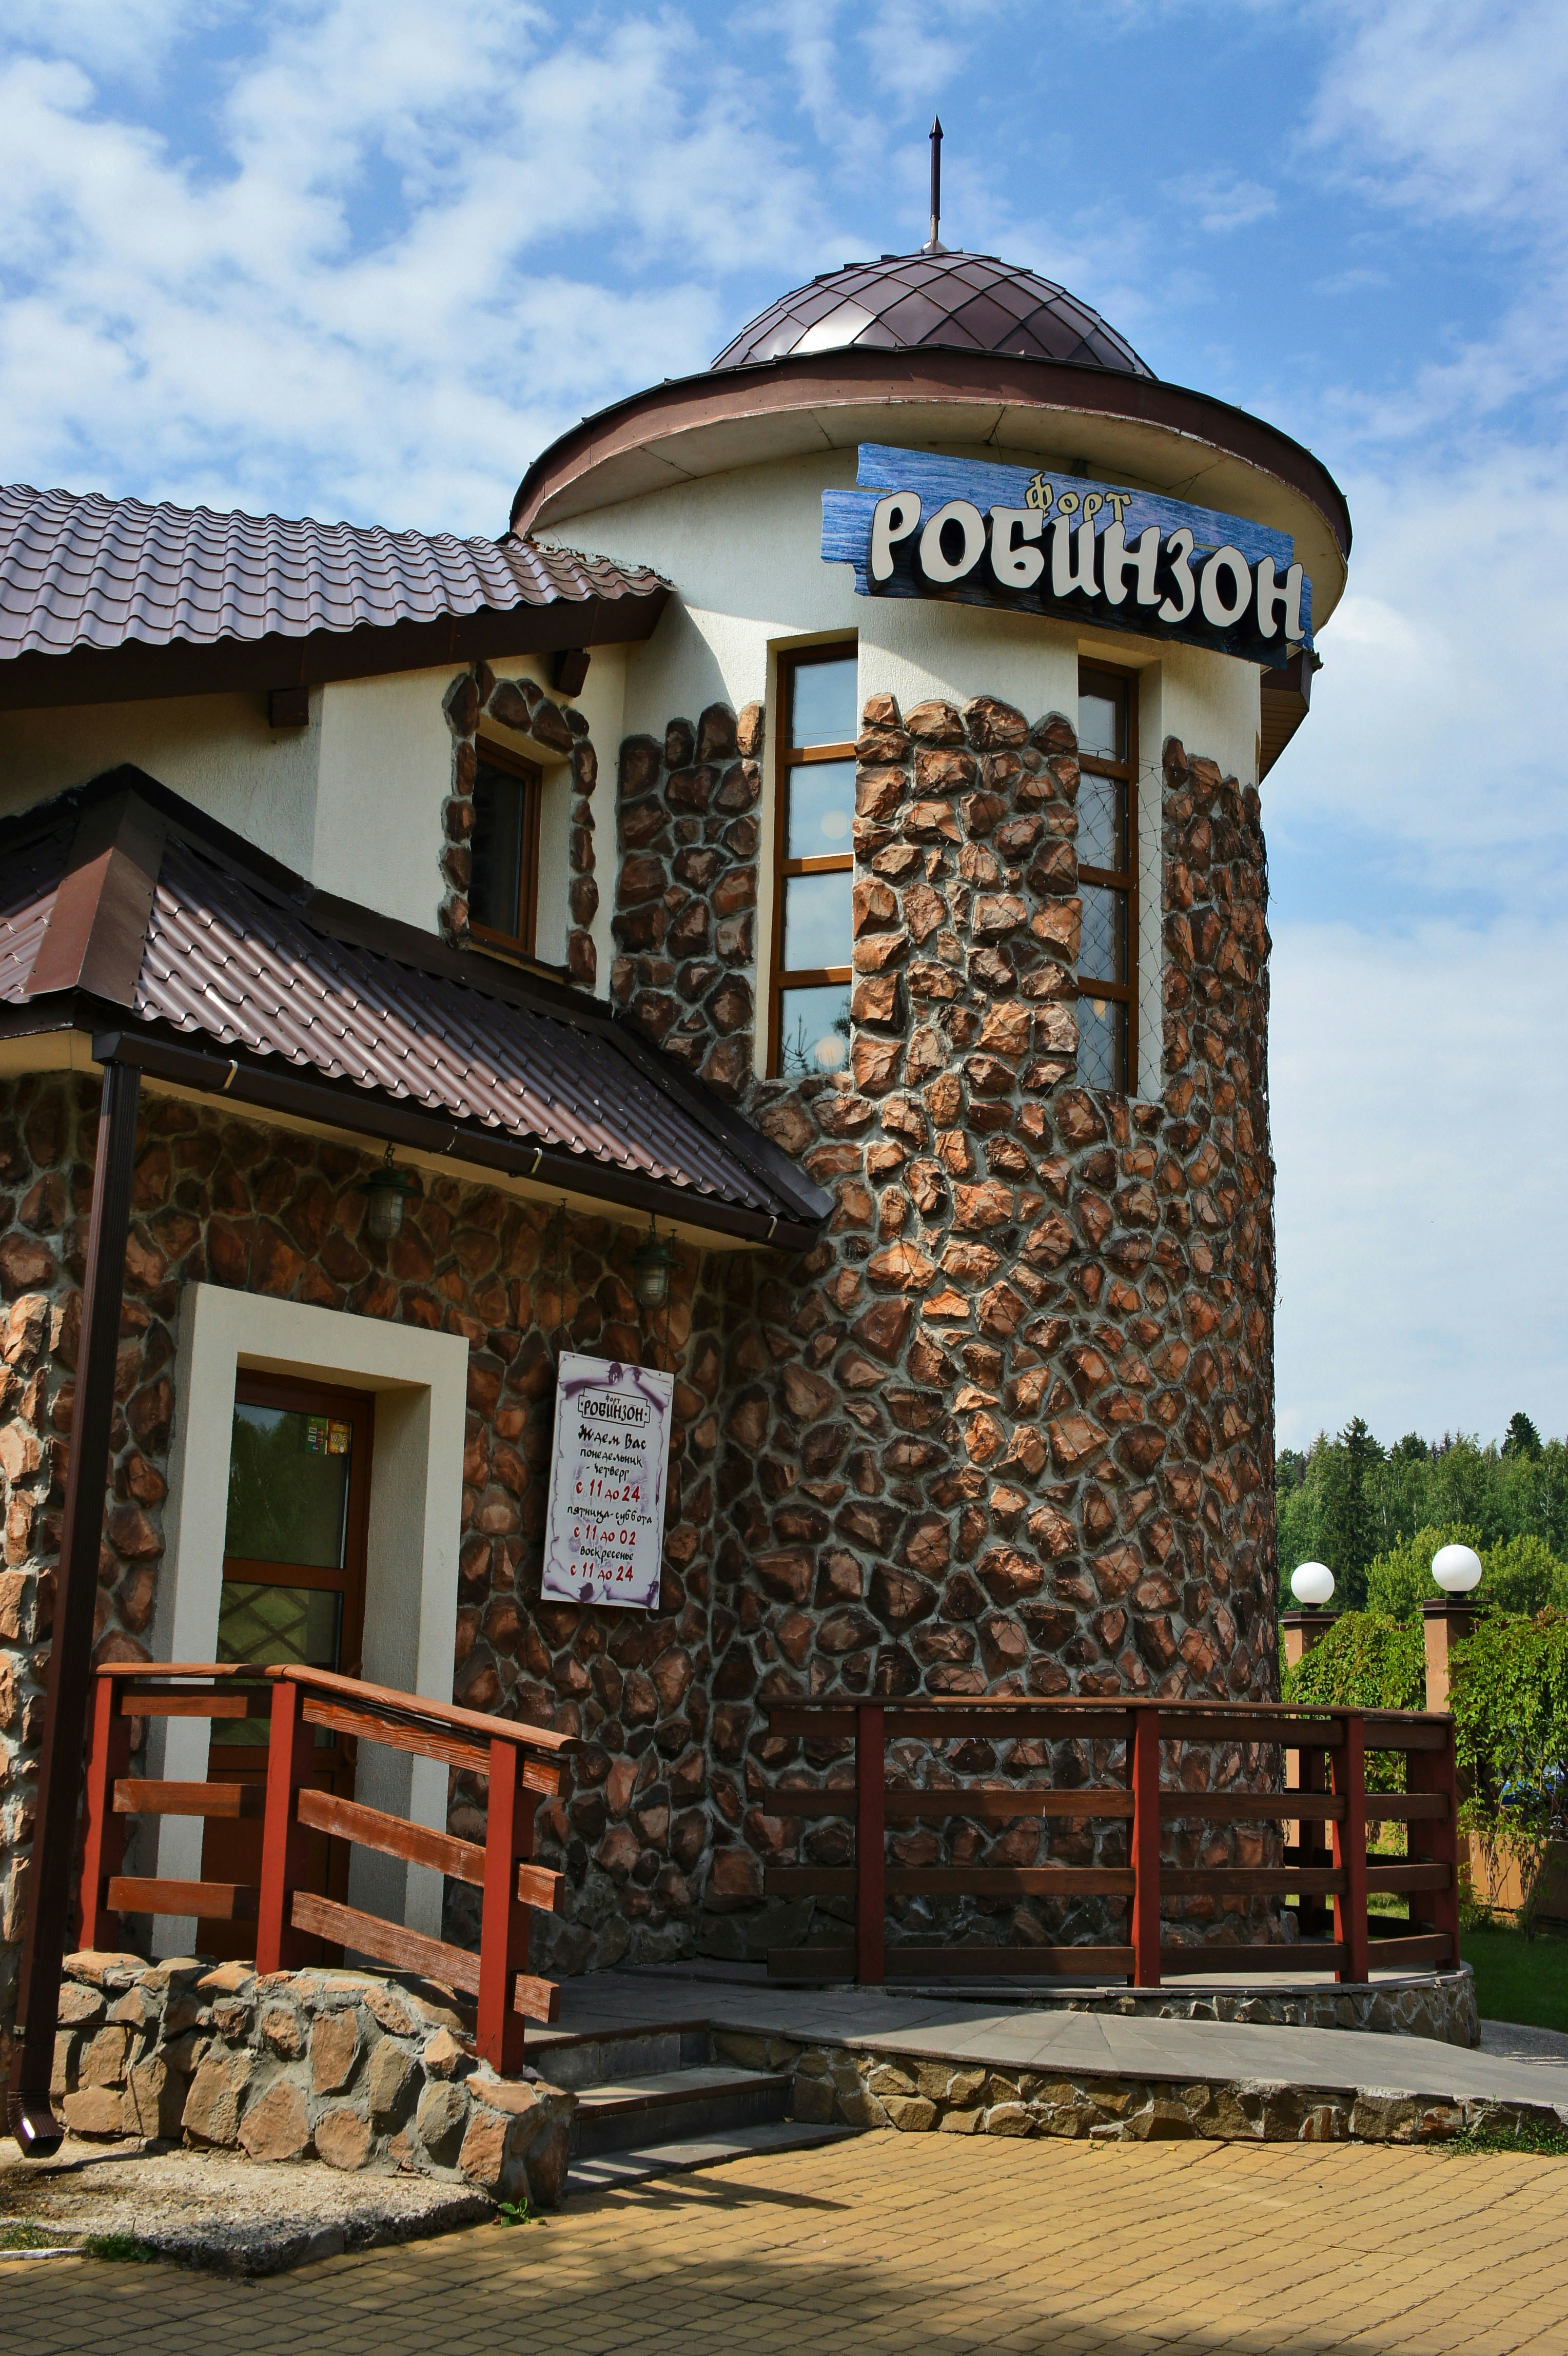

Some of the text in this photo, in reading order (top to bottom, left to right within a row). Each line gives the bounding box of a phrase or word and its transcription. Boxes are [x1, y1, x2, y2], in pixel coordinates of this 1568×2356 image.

[1026, 472, 1131, 521] форт
[870, 490, 1306, 641] РОБИНЗОН
[605, 1393, 621, 1405] форт
[578, 1424, 646, 1449] Ждем Вас
[580, 1448, 643, 1467] понедельник
[590, 1479, 602, 1497] 11
[604, 1489, 619, 1503] до
[622, 1485, 640, 1502] 24
[586, 1524, 597, 1540] 11
[600, 1531, 615, 1545] до
[620, 1529, 636, 1545] 02
[580, 1546, 634, 1563] воскресенье
[583, 1562, 594, 1578] 11
[598, 1569, 612, 1584] до
[616, 1565, 633, 1582] 24
